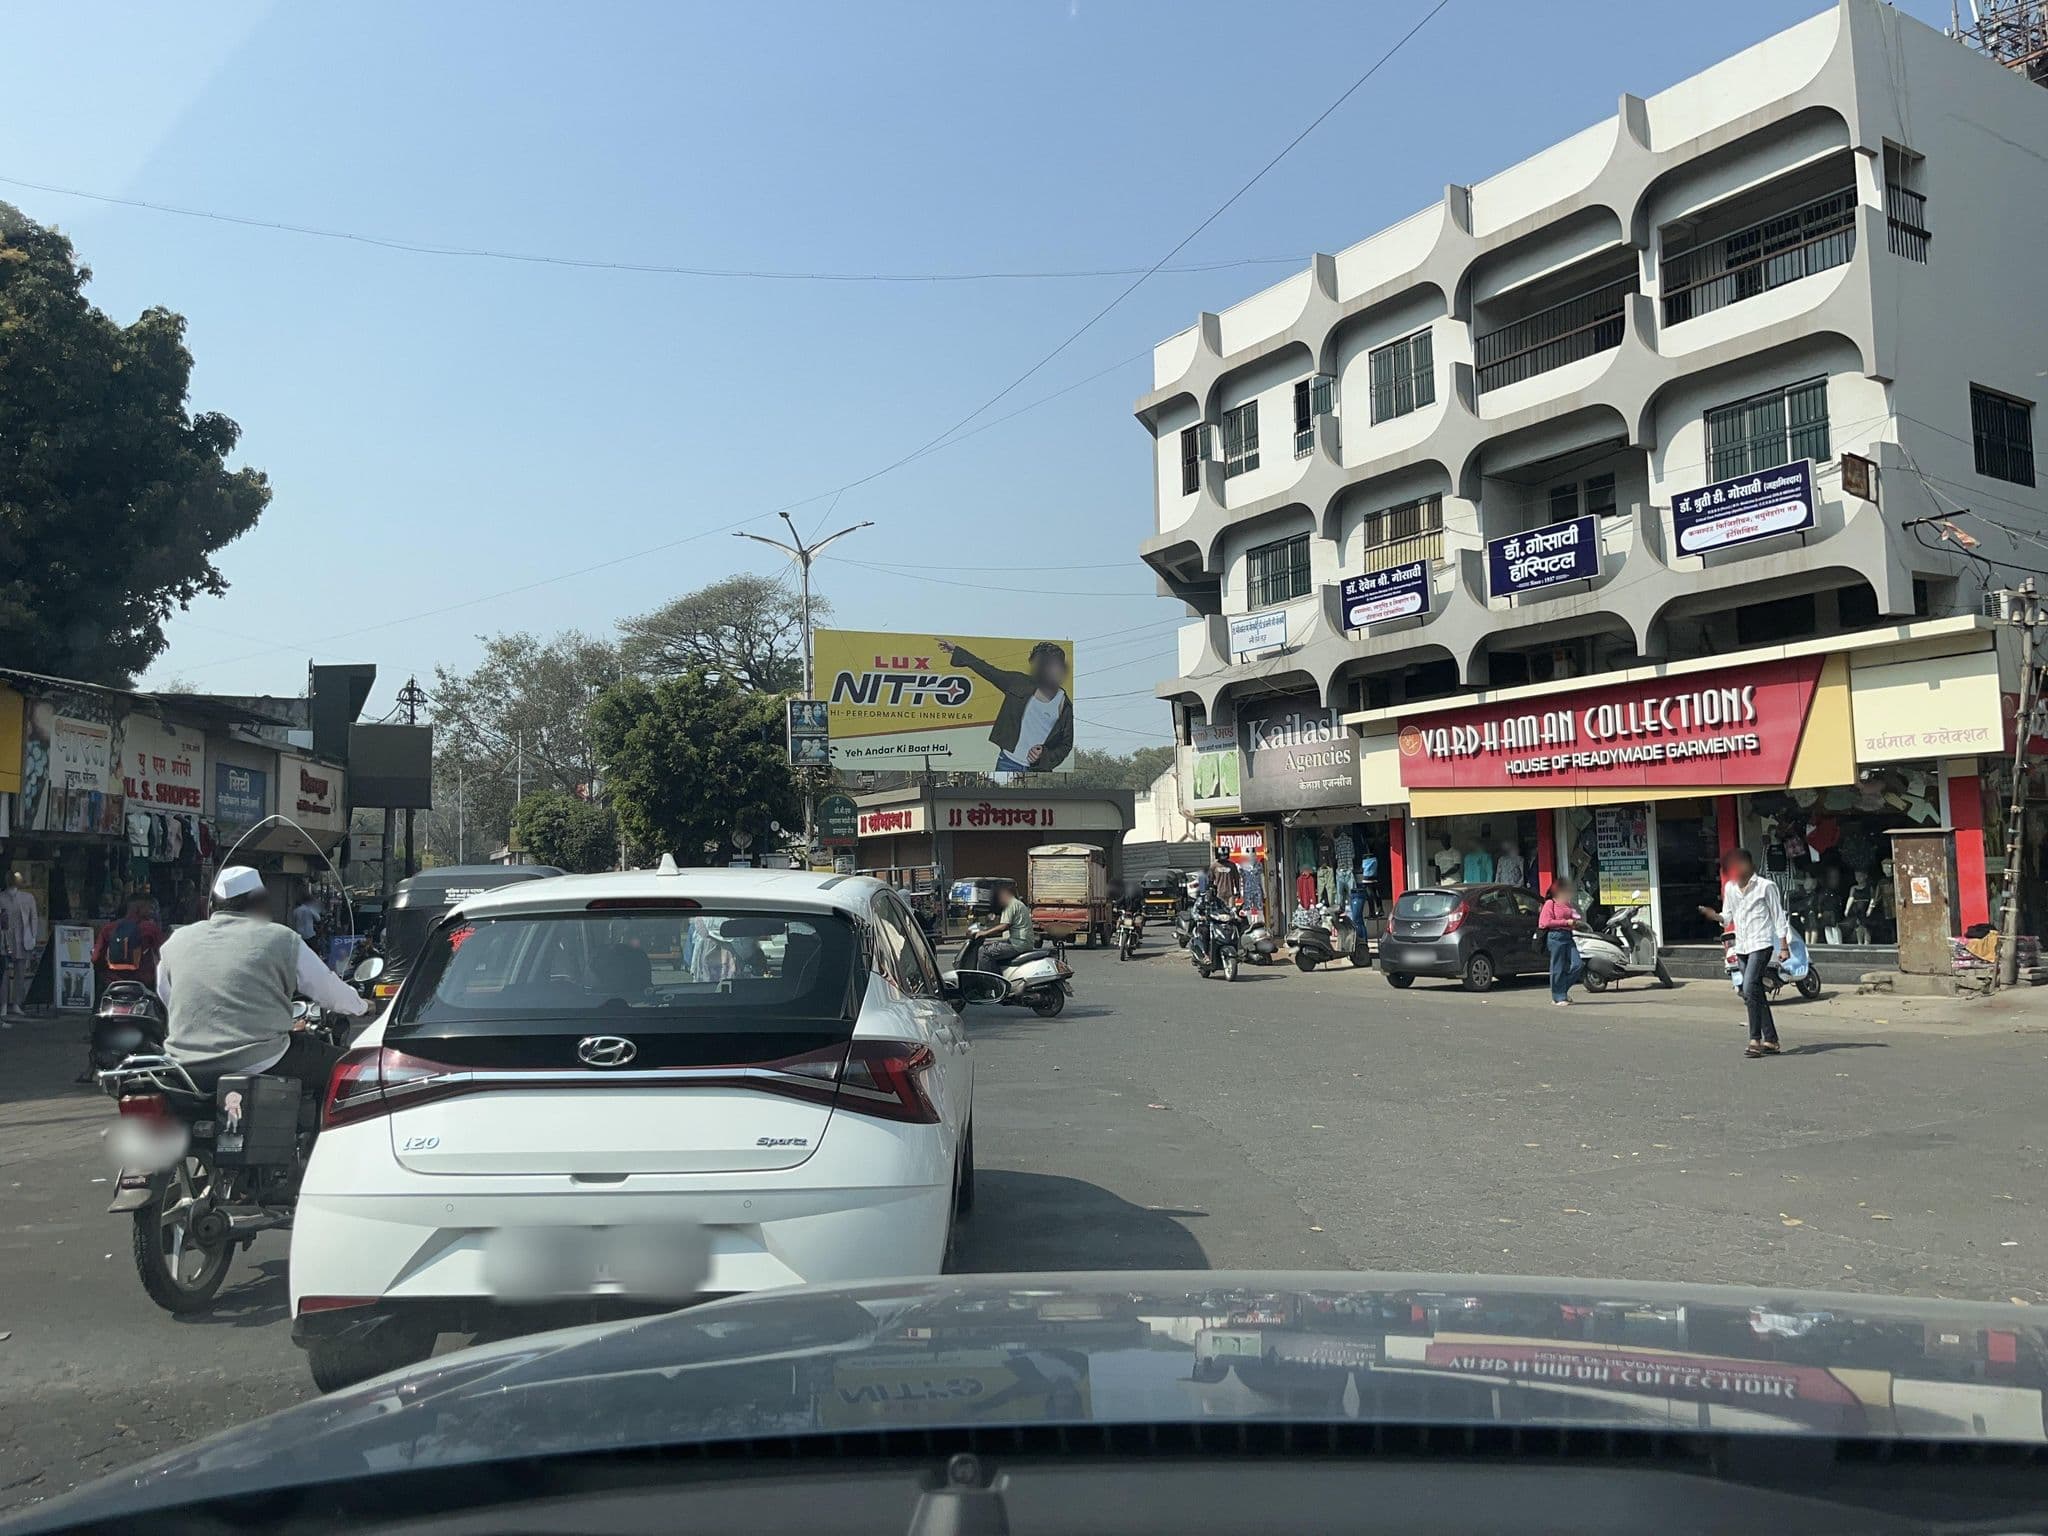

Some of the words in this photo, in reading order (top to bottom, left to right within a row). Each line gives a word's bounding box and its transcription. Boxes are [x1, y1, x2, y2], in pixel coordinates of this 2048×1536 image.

[1679, 498, 1692, 513] डॉ.
[1713, 489, 1726, 504] डी.
[1727, 478, 1761, 500] गोसावी
[1503, 538, 1525, 560] डॉ.
[1525, 524, 1579, 554] गोसावी
[1346, 581, 1357, 595] डॉ.
[1391, 564, 1421, 582] गोसावी
[1508, 551, 1576, 582] हॉस्पिटल
[875, 656, 930, 669] LUX
[830, 710, 916, 719] HI-PERFORMANCE
[919, 711, 973, 720] INNERWEAR
[1421, 710, 1577, 759] VARDHAMAN
[1584, 685, 1757, 739] COLLECTIONS
[1247, 708, 1349, 753] Kailash
[1864, 731, 1917, 751] वर्धमान
[1921, 727, 1989, 745] कलेक्शन
[845, 748, 863, 757] Yeh
[865, 746, 895, 756] Andar
[896, 744, 907, 753] Ki
[908, 744, 930, 753] Baat
[932, 743, 948, 752] Hai
[1285, 744, 1351, 774] Agencies
[1504, 757, 1552, 775] HOUSE
[1552, 755, 1570, 770] OF
[1572, 743, 1665, 768] READYMADE
[1666, 733, 1760, 758] GARMENTS
[152, 755, 166, 776] एस
[156, 782, 201, 808] SHOPEE
[868, 810, 903, 832] सौभाग्य
[967, 803, 1037, 826] सौभाग्य
